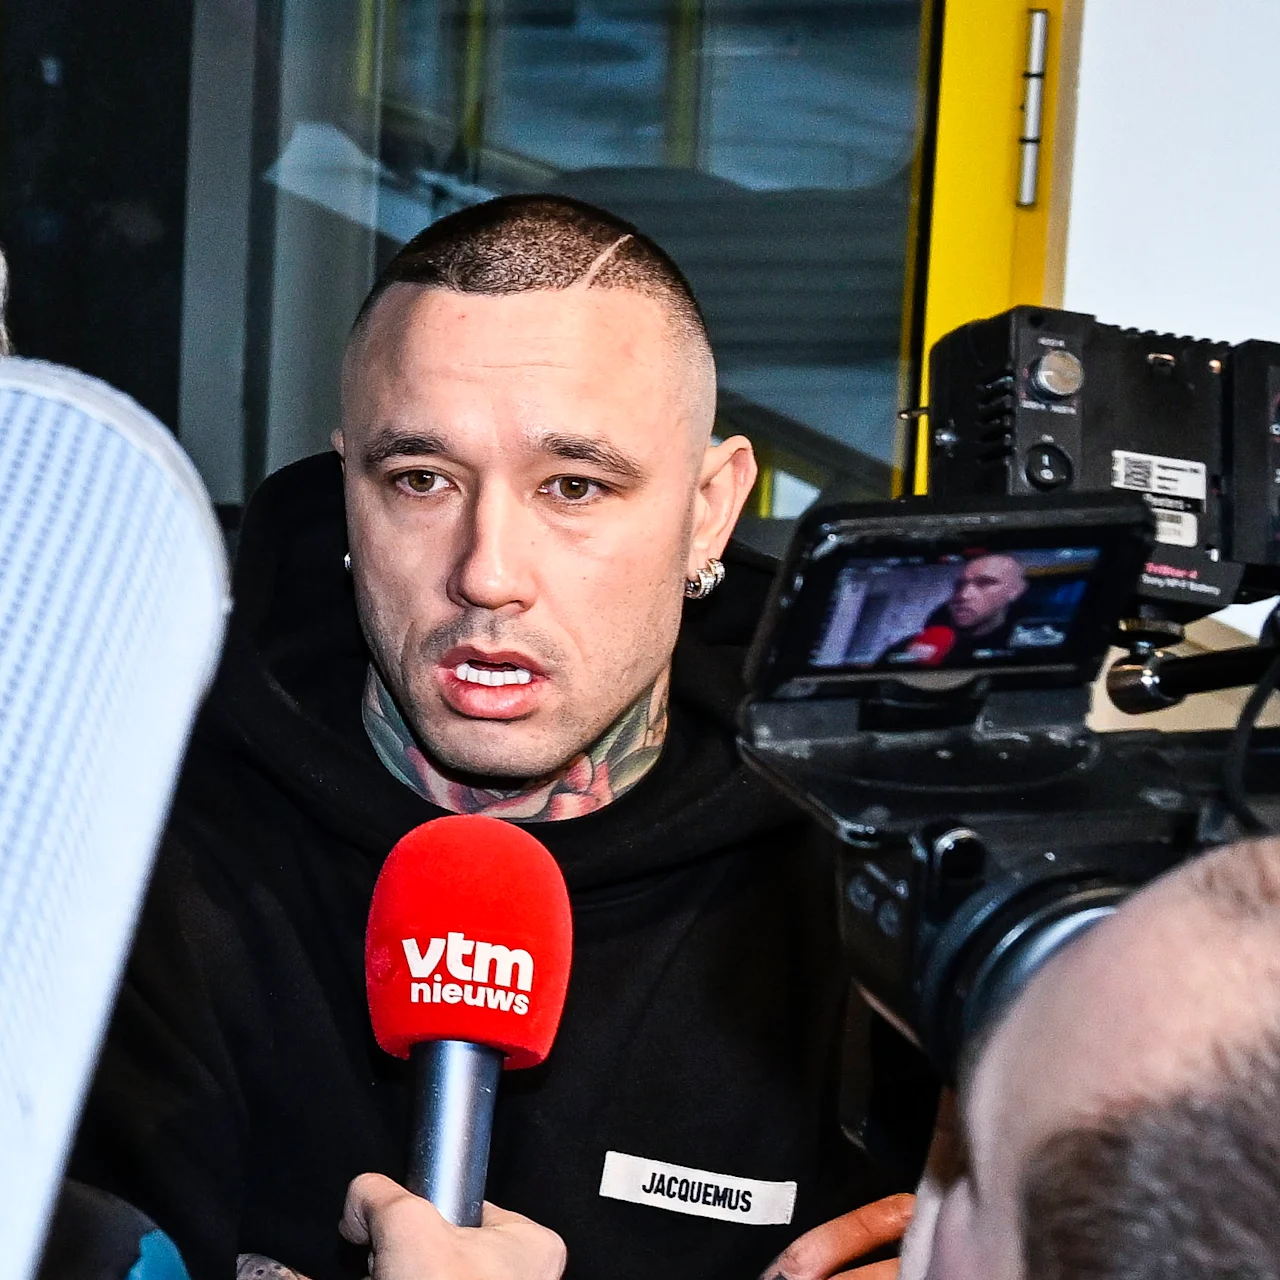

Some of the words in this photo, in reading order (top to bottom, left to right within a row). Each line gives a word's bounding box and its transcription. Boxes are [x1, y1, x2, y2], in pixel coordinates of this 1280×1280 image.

[402, 931, 535, 992] vtm
[410, 973, 530, 1015] nieuws
[641, 1172, 753, 1213] JACQUEMUS
